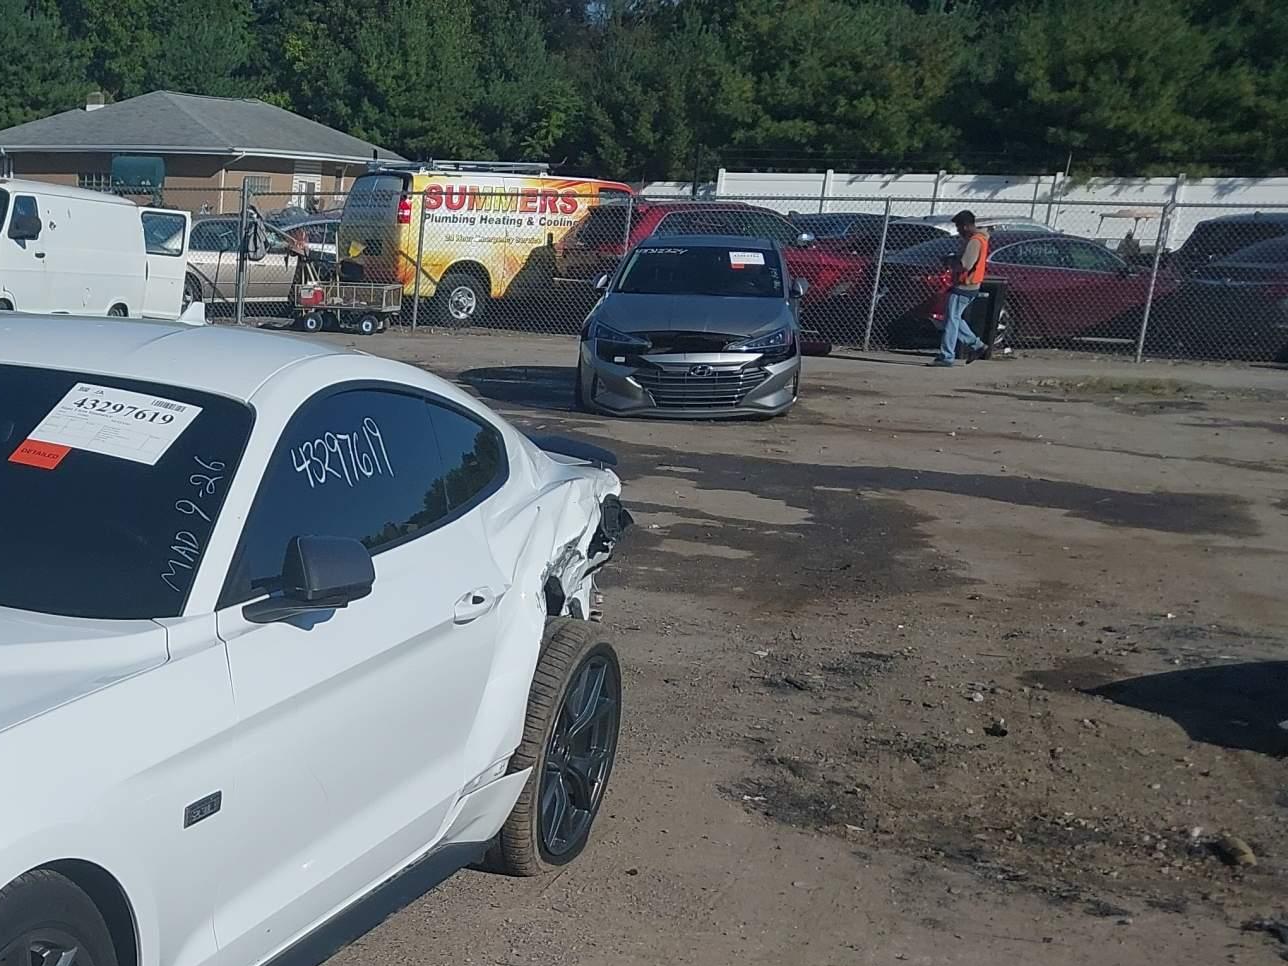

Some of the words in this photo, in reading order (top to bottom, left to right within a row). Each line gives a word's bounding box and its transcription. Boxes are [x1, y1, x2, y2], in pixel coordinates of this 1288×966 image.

[423, 183, 579, 215] SUMMERS
[423, 213, 476, 226] Plumbing
[479, 215, 523, 227] Heating
[526, 217, 535, 226] &
[73, 397, 175, 425] 43297619
[290, 417, 395, 488] 43297619
[160, 530, 201, 592] MAD
